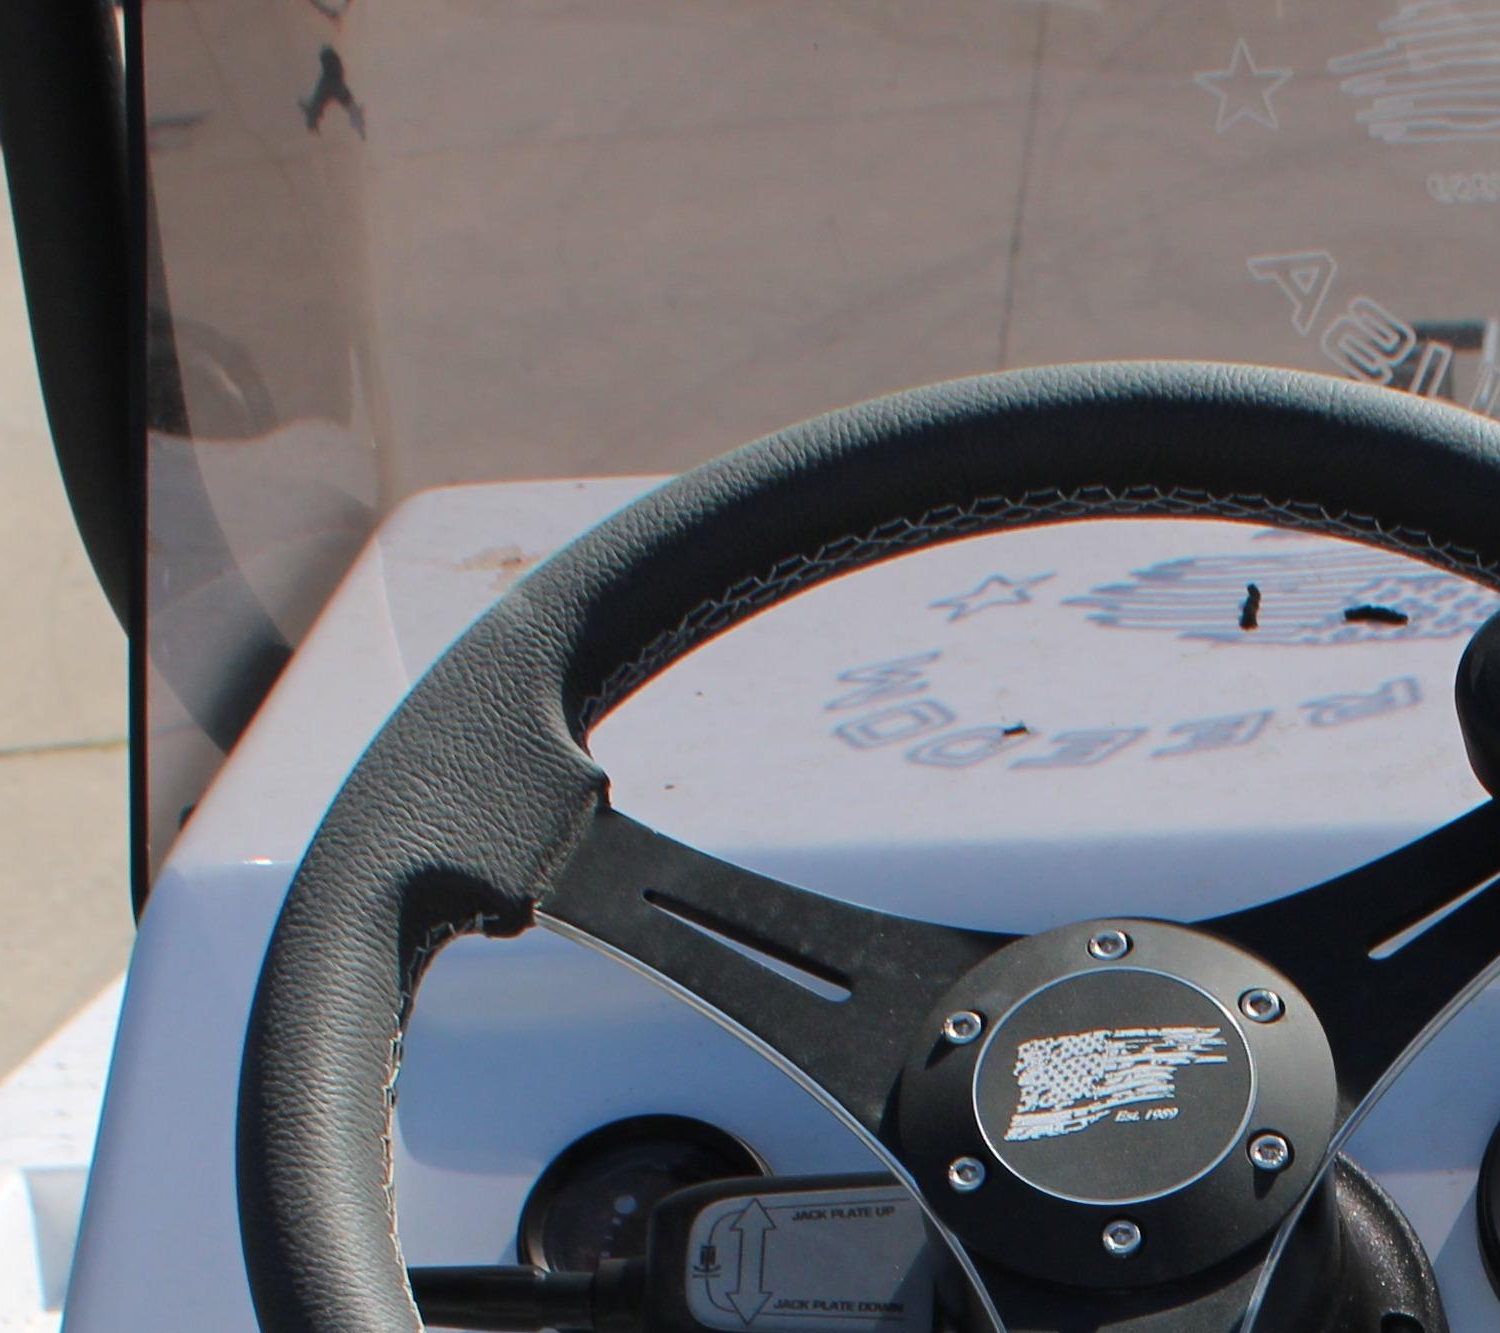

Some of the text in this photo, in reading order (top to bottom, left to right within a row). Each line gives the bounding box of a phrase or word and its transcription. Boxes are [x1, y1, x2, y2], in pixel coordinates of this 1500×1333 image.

[792, 1206, 895, 1221] JACK PLATE UP
[774, 1299, 905, 1313] JACK PLATE DOWN
